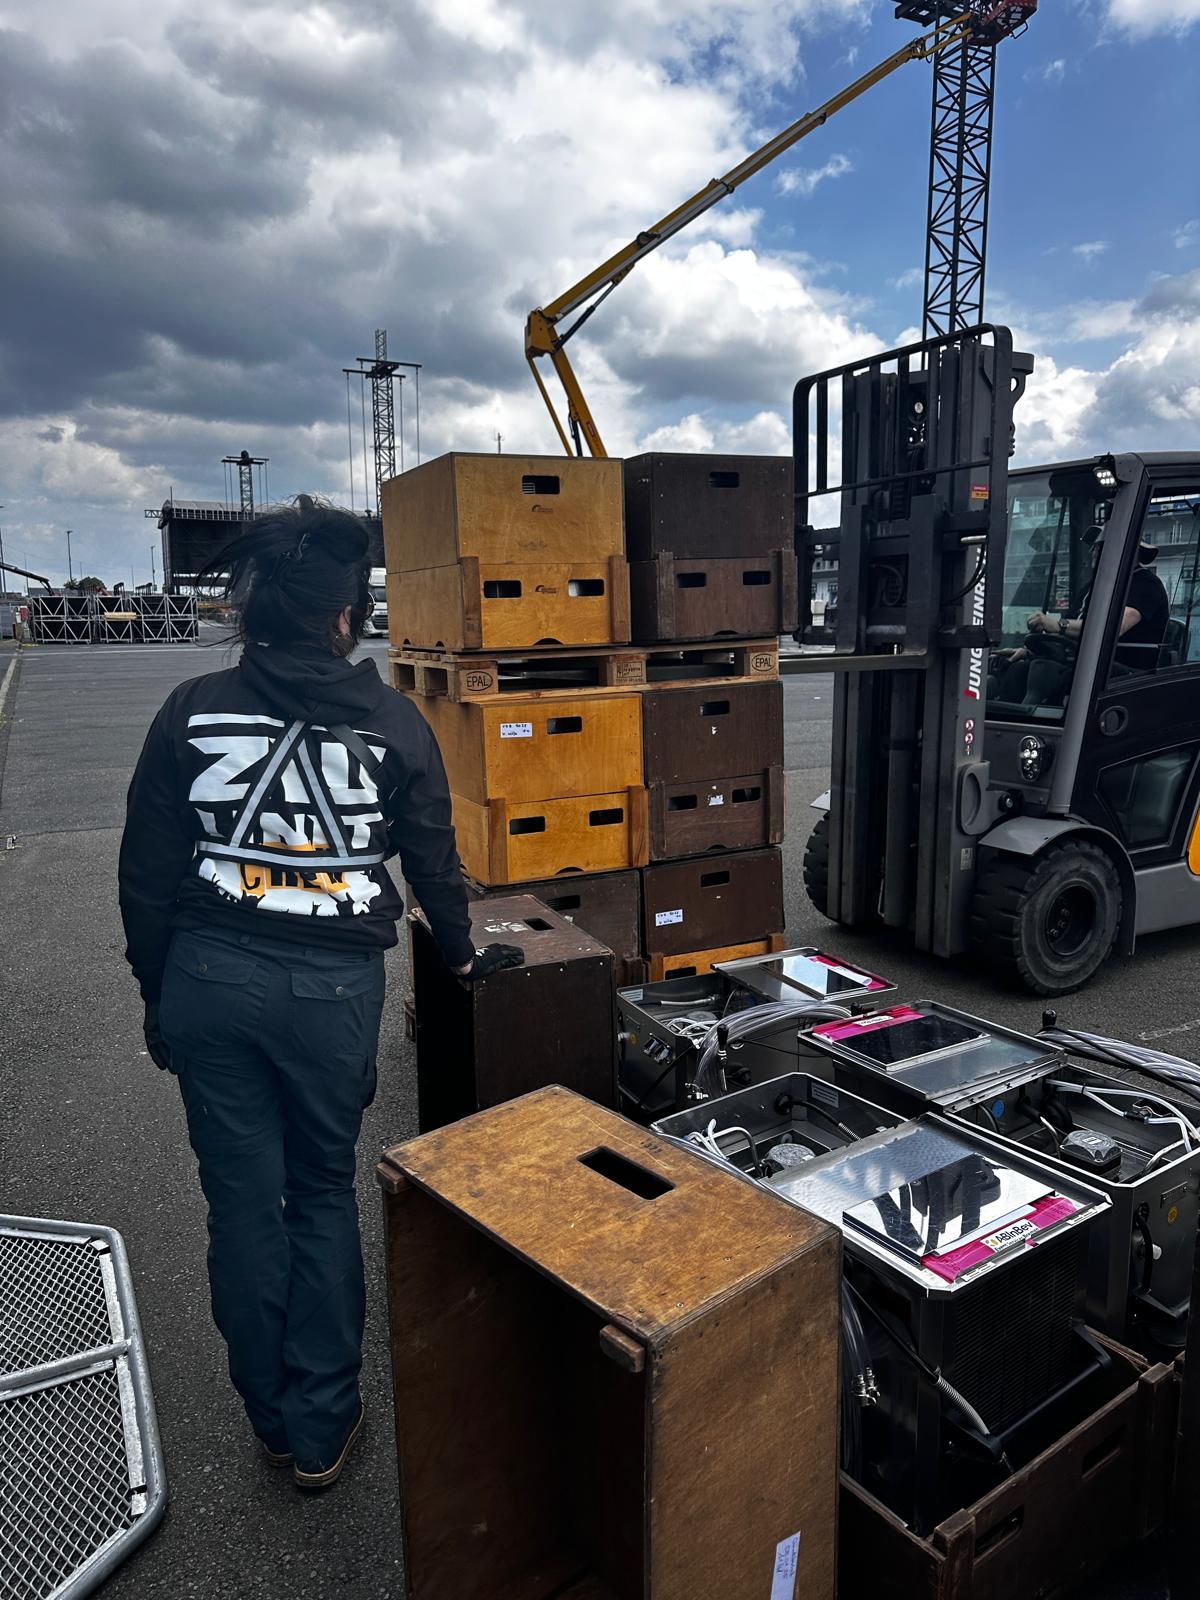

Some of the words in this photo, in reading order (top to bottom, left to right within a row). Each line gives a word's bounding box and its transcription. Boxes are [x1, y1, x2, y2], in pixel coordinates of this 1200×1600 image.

[968, 547, 987, 701] JUNGEINR
[755, 657, 773, 668] EPAL
[466, 675, 488, 688] EPAL
[995, 1221, 1033, 1243] ABInBev
